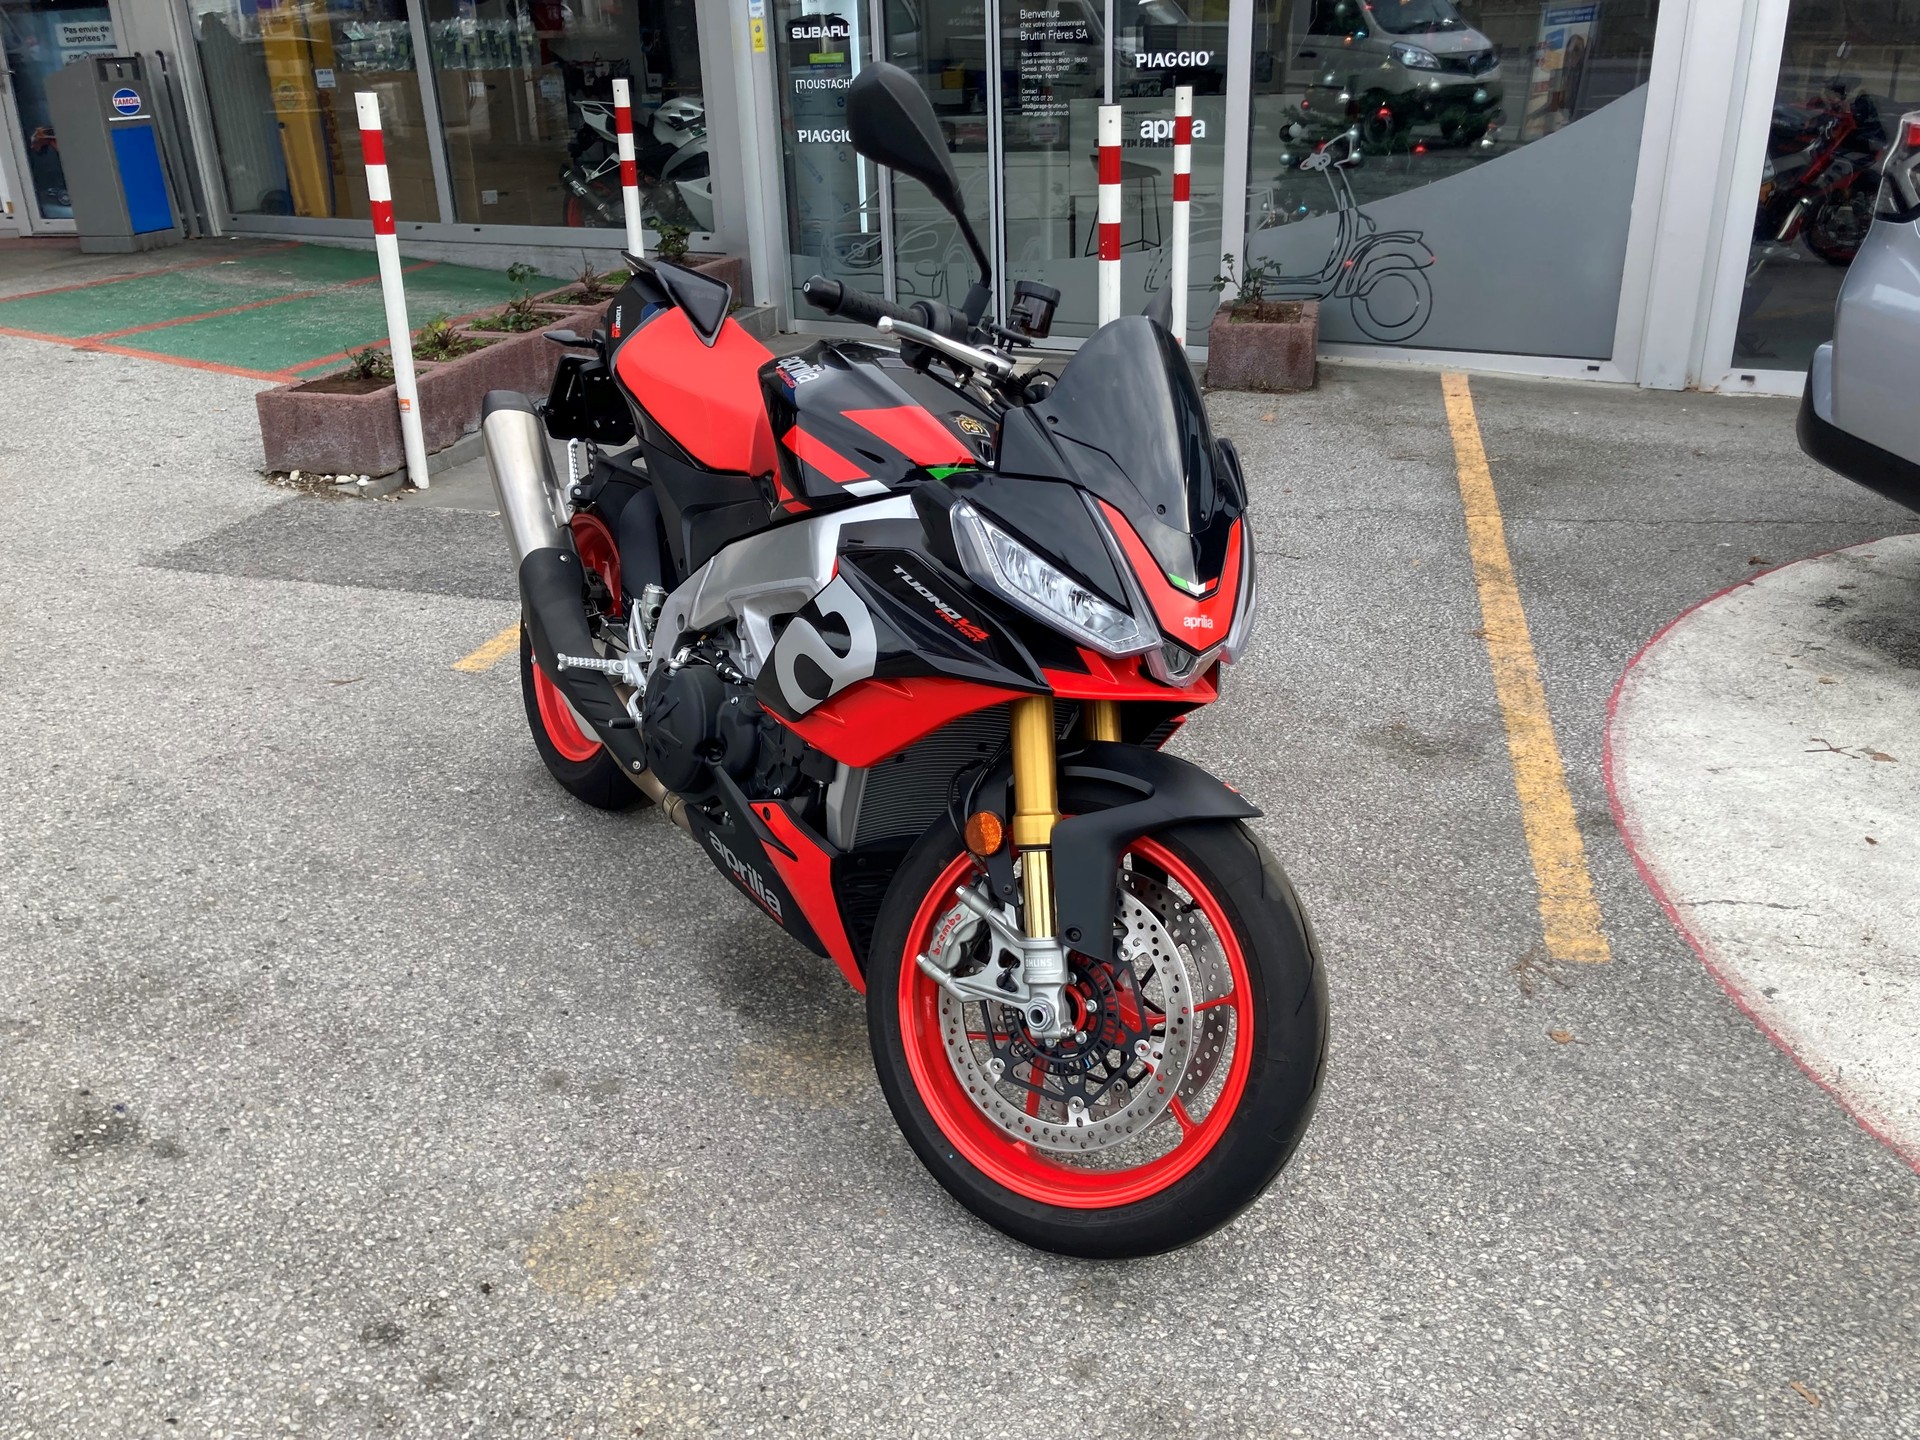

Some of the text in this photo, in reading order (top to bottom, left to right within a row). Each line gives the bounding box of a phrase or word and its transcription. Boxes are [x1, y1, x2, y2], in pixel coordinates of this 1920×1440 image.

[1020, 9, 1060, 19] Bienvenue
[63, 26, 78, 34] Pas
[1046, 20, 1086, 28] concessionnaire
[66, 34, 101, 43] surprises
[791, 25, 850, 39] SUBARU
[1020, 28, 1089, 41] Bruttin Frères SA
[1135, 51, 1210, 68] PIAGGIO
[114, 97, 140, 106] TAMOIL
[1140, 119, 1206, 143] apra
[893, 564, 963, 620] TUONO
[1183, 614, 1214, 630] aprilia
[709, 830, 783, 917] aprilia
[933, 913, 962, 956] brembo
